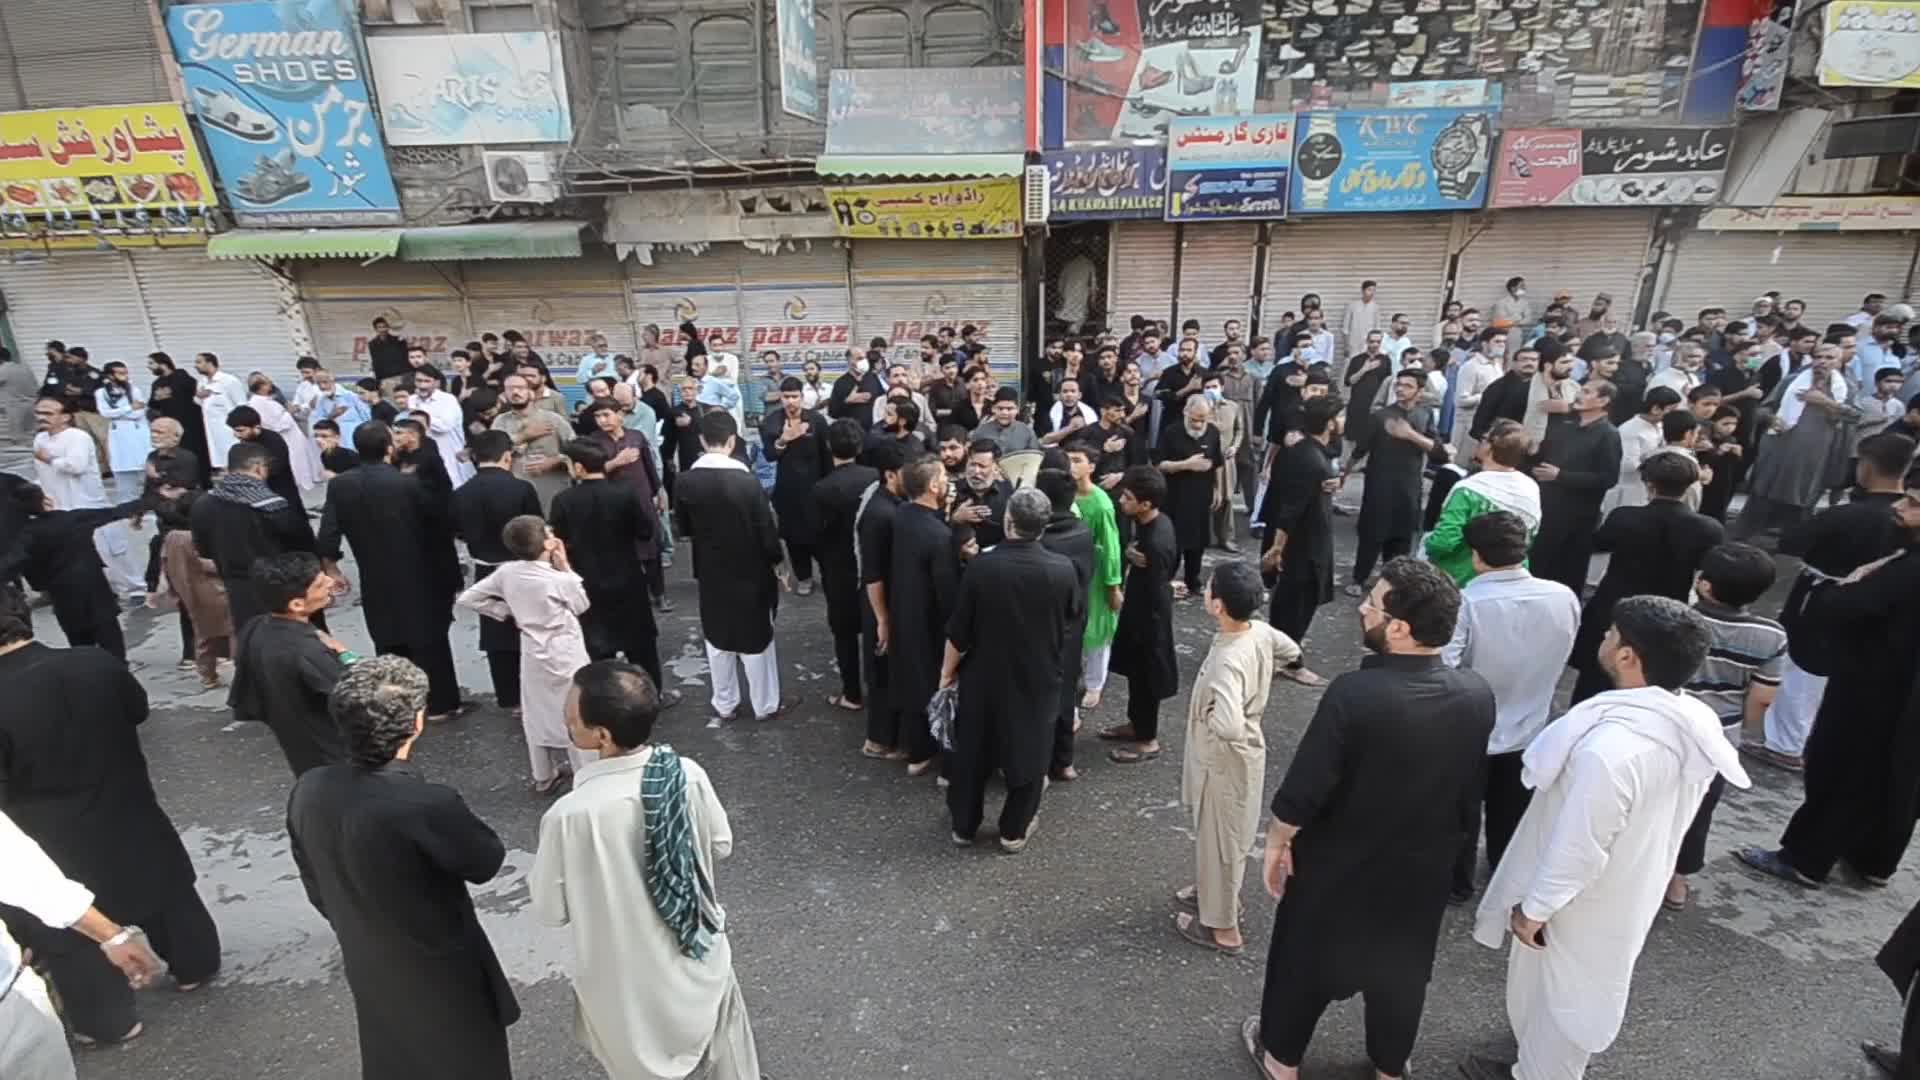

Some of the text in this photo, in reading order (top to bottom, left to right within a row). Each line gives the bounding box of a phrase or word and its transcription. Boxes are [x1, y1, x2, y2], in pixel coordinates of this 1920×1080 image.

[183, 9, 348, 61] German
[233, 59, 357, 84] SHOES
[749, 325, 850, 352] parwaz
